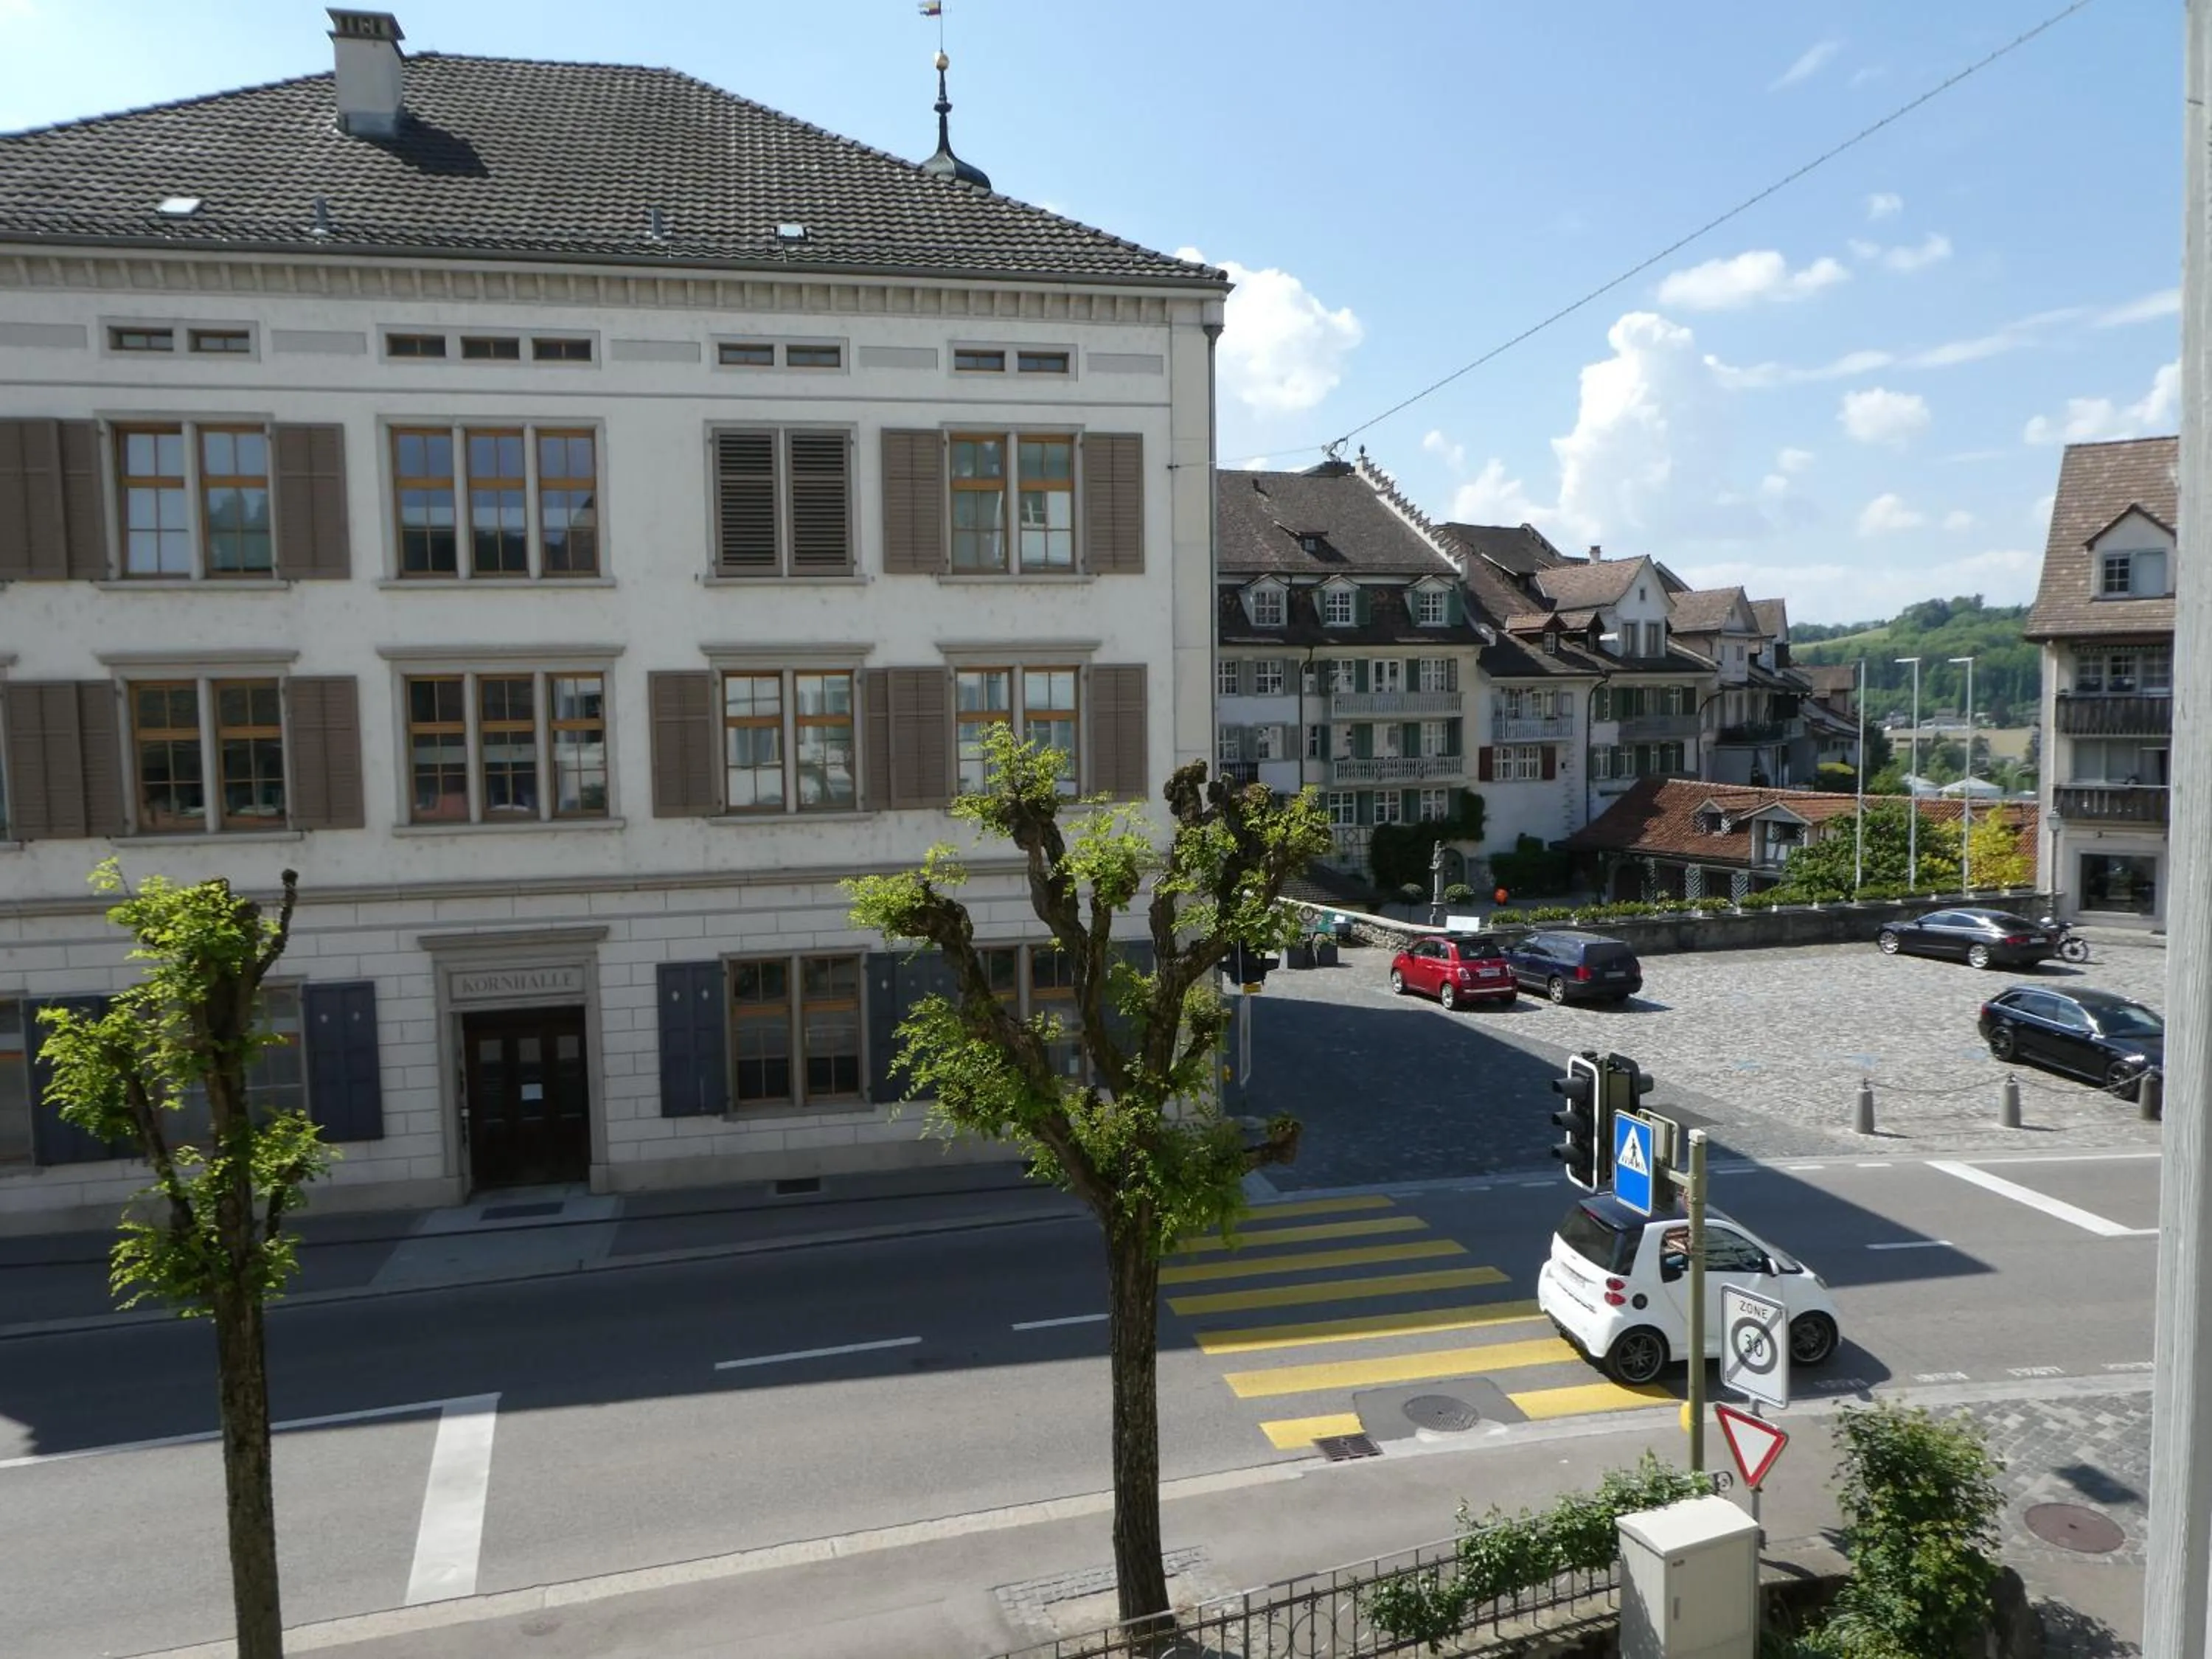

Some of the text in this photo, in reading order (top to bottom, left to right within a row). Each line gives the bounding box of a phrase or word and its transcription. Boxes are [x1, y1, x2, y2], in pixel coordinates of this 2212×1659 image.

[462, 972, 574, 993] KORNHALLE
[1739, 1301, 1768, 1320] ZONE
[1745, 1335, 1763, 1357] 30
